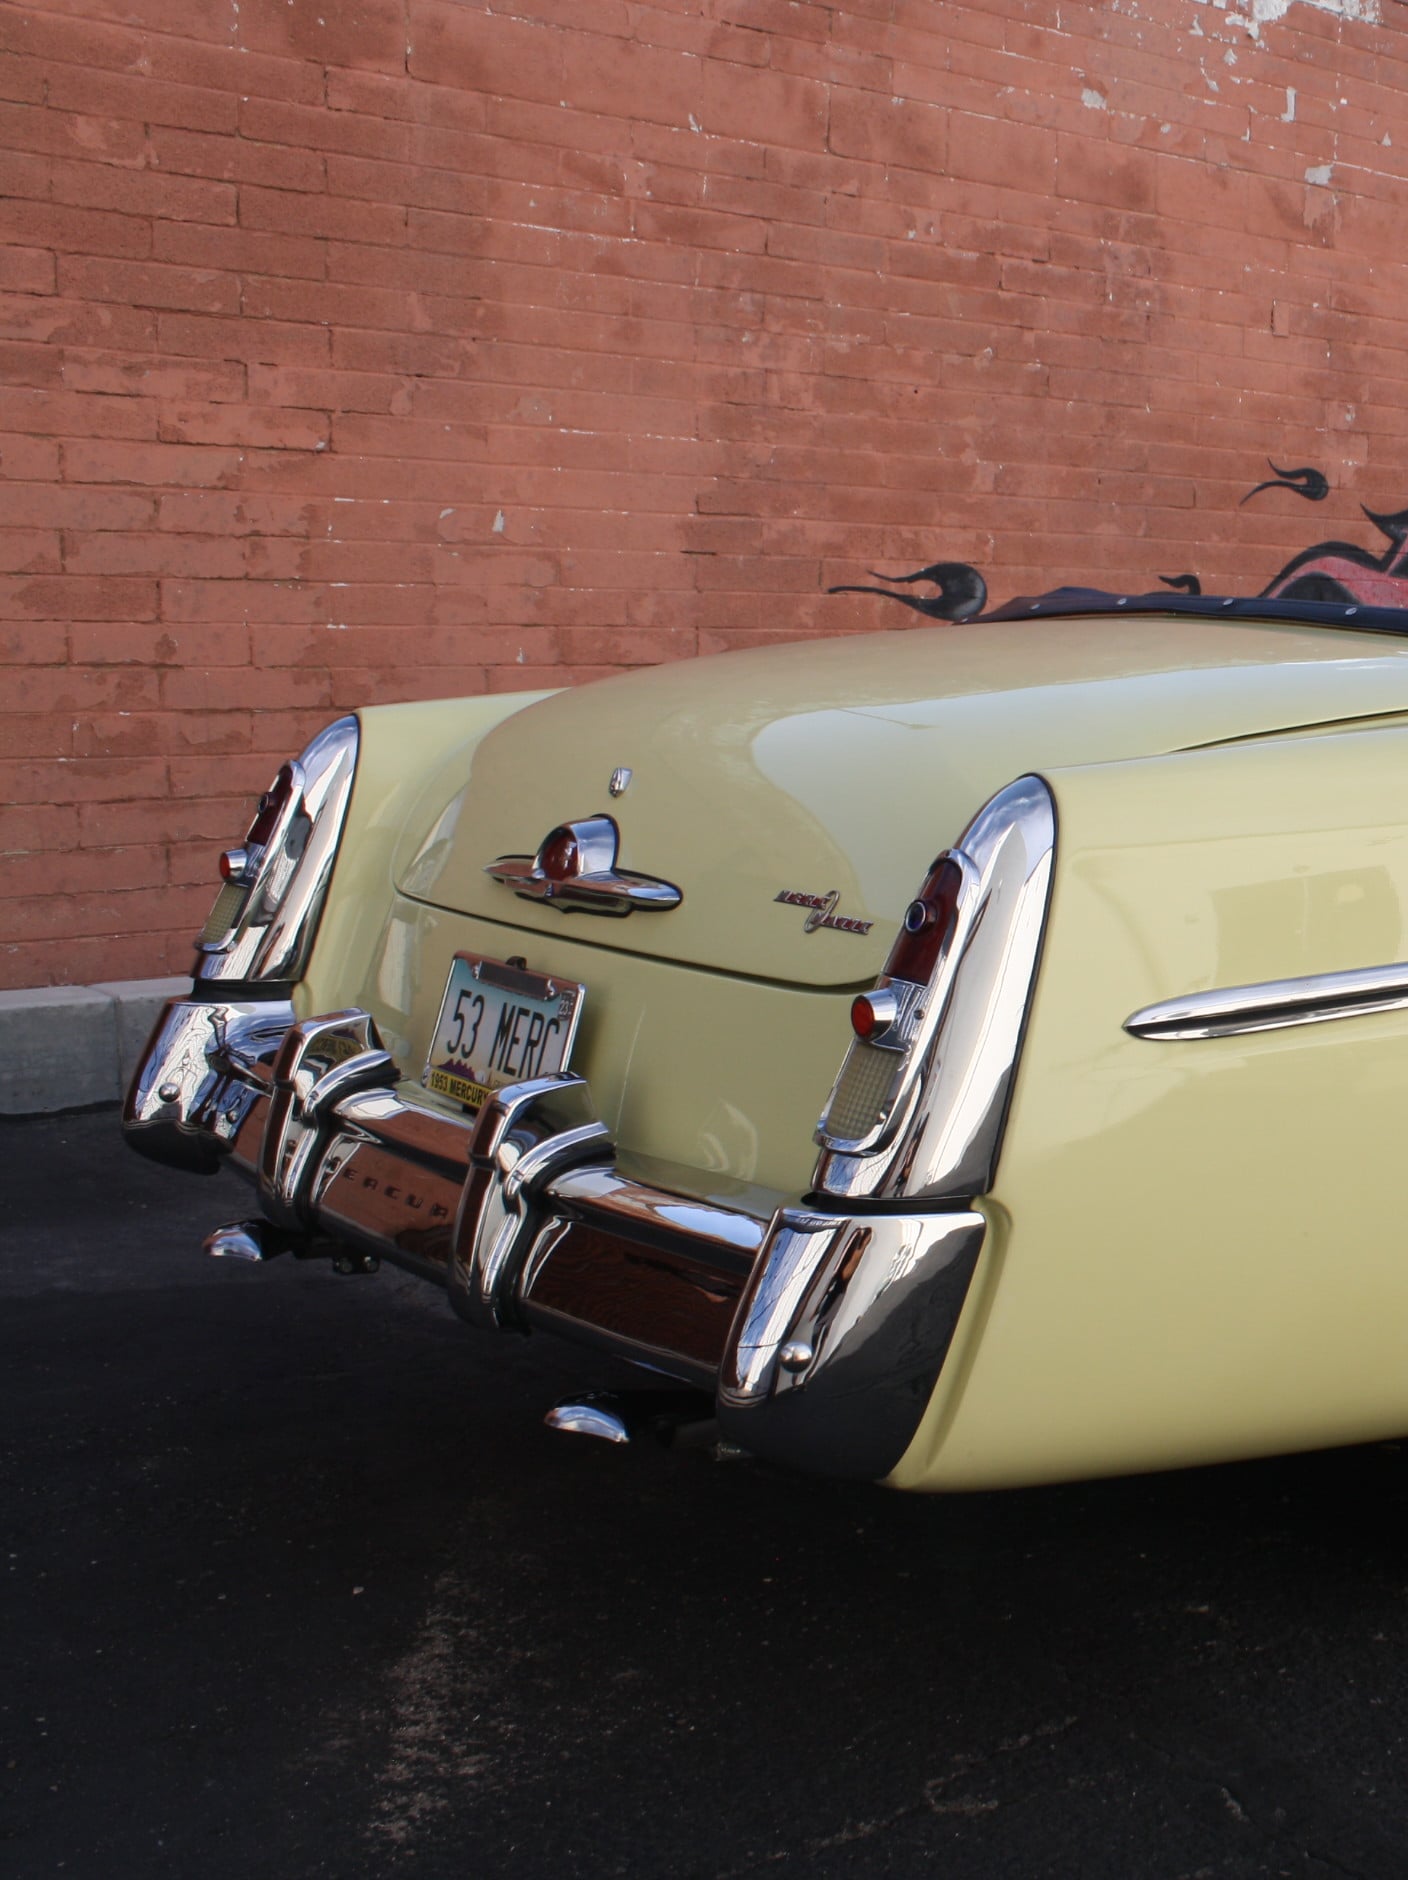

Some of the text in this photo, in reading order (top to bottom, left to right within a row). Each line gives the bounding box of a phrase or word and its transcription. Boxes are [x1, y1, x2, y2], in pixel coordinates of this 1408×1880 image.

[446, 989, 561, 1080] 53 MERC
[431, 1070, 449, 1092] 1953
[342, 1167, 450, 1220] ERCUR
